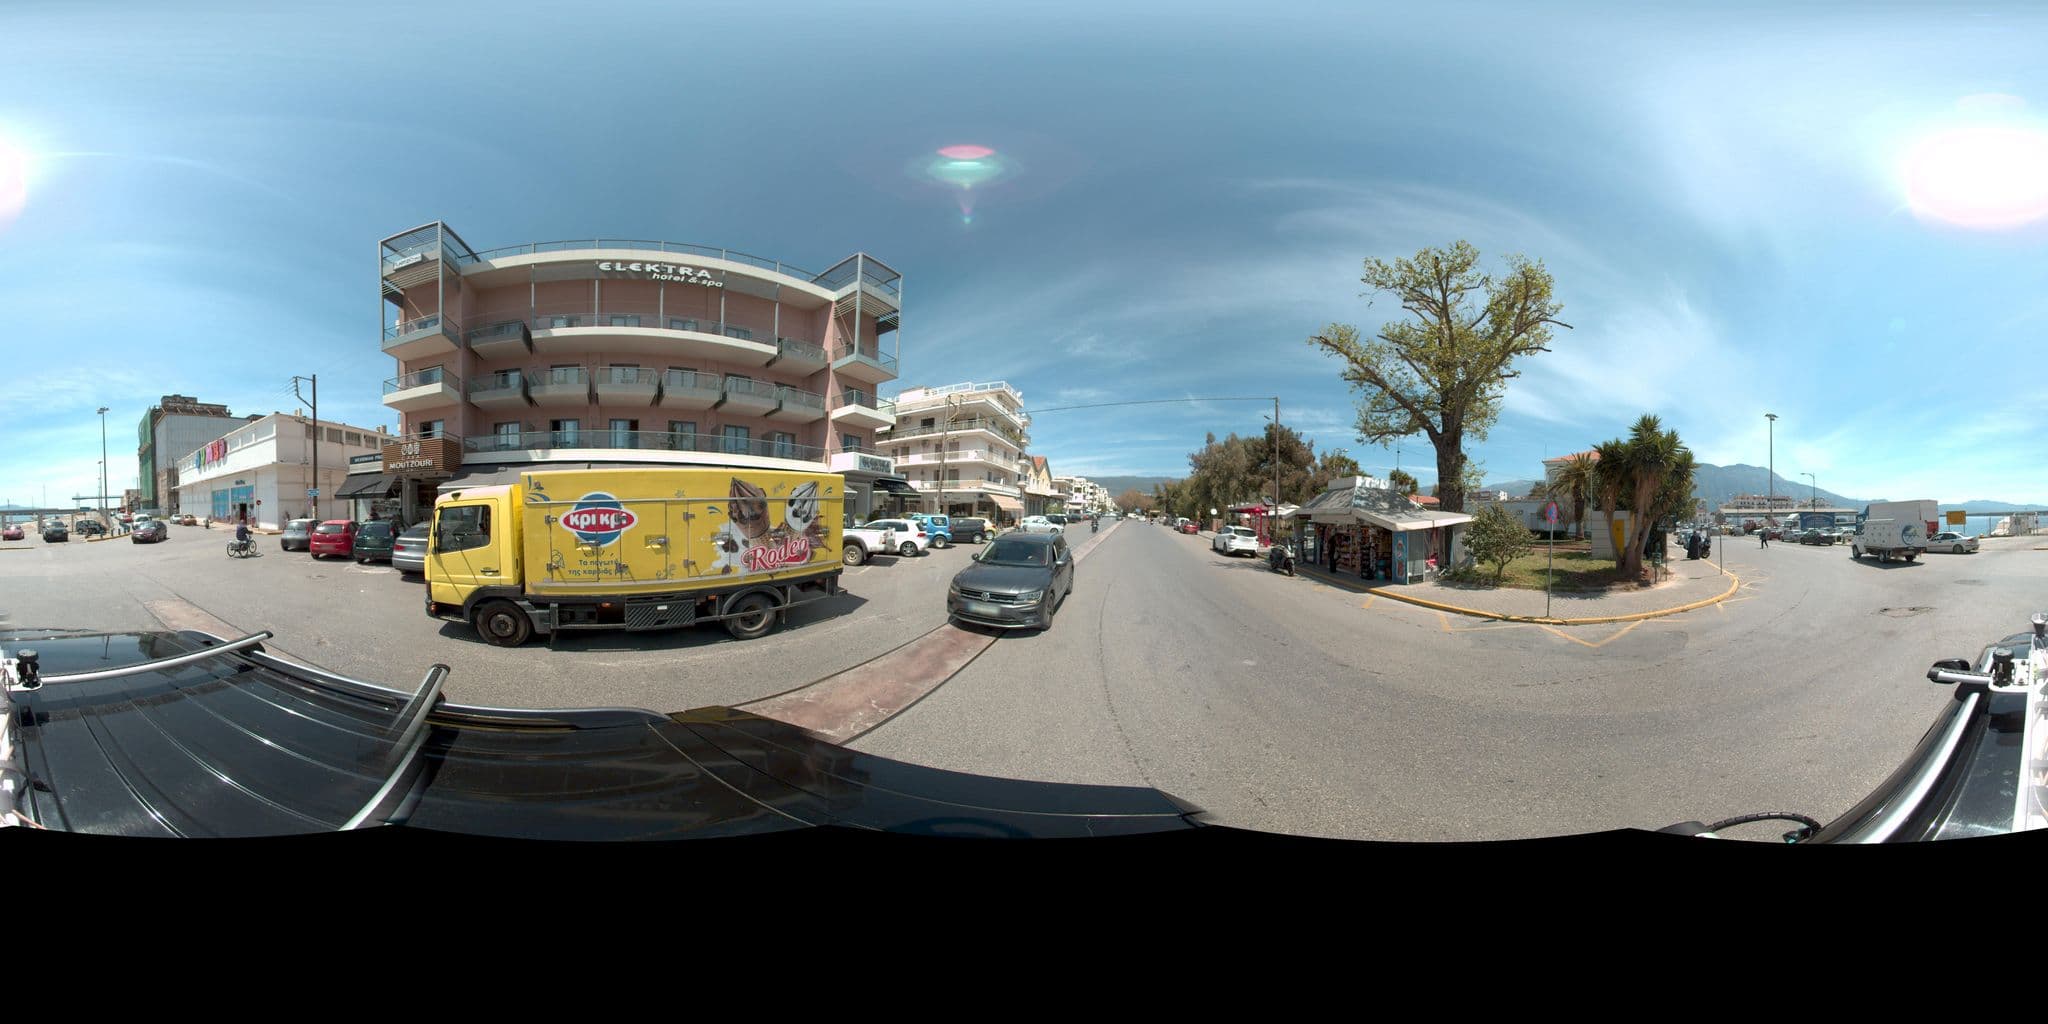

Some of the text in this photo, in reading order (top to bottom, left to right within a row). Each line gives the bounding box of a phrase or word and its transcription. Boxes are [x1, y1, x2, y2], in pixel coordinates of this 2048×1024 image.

[599, 262, 712, 278] ELEKTRA
[652, 272, 723, 287] hotel & spa
[569, 513, 597, 529] κρι
[741, 535, 809, 571] Rodeo
